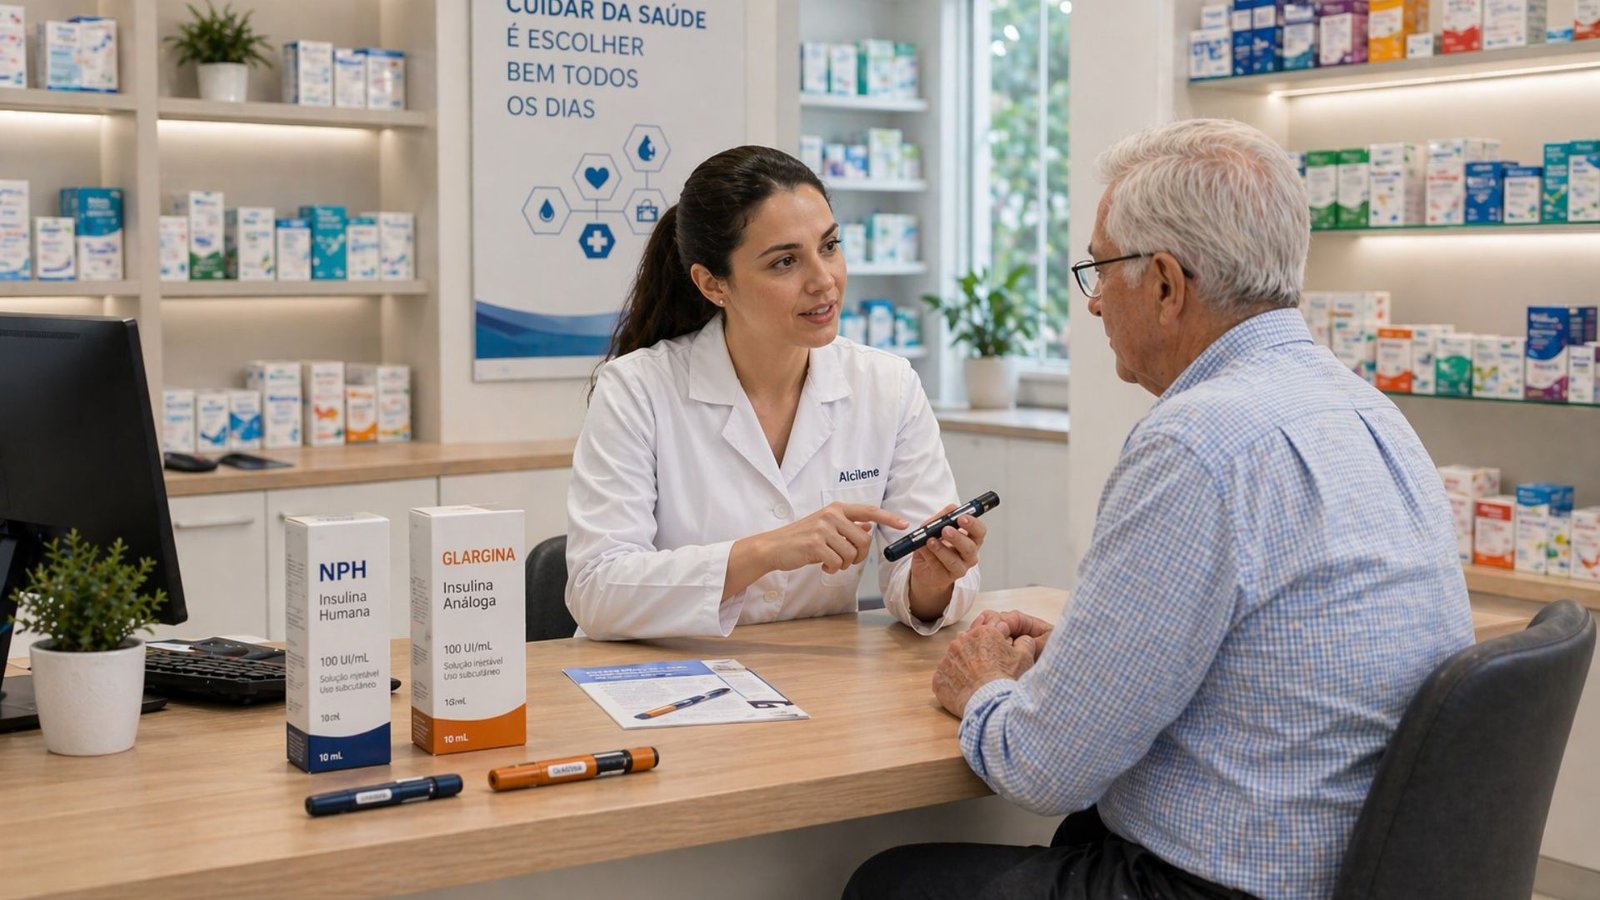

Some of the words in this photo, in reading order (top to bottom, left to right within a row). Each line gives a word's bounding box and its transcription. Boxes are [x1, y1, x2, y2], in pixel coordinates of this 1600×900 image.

[506, 0, 594, 19] CUIDAR
[602, 2, 632, 23] DA
[639, 3, 707, 29] SAÚDE
[507, 22, 519, 47] É
[528, 29, 644, 56] ESCOLHER
[507, 61, 555, 84] BEM
[562, 64, 639, 89] TODOS
[507, 95, 537, 117] OS
[546, 97, 595, 119] DIAS
[839, 468, 879, 483] Alcilene
[442, 547, 516, 566] GLARGINA
[319, 559, 366, 582] NPH
[443, 580, 494, 594] Insulina
[319, 591, 367, 606] Insulina
[443, 596, 497, 611] Análoga
[319, 607, 370, 621] Humana
[444, 643, 462, 655] 100
[463, 641, 493, 653] UI/mL
[320, 656, 338, 667] 100
[340, 652, 370, 665] UI/mL
[443, 735, 454, 744] 10
[455, 733, 469, 743] mL
[319, 753, 329, 762] 10
[330, 751, 343, 761] mL
